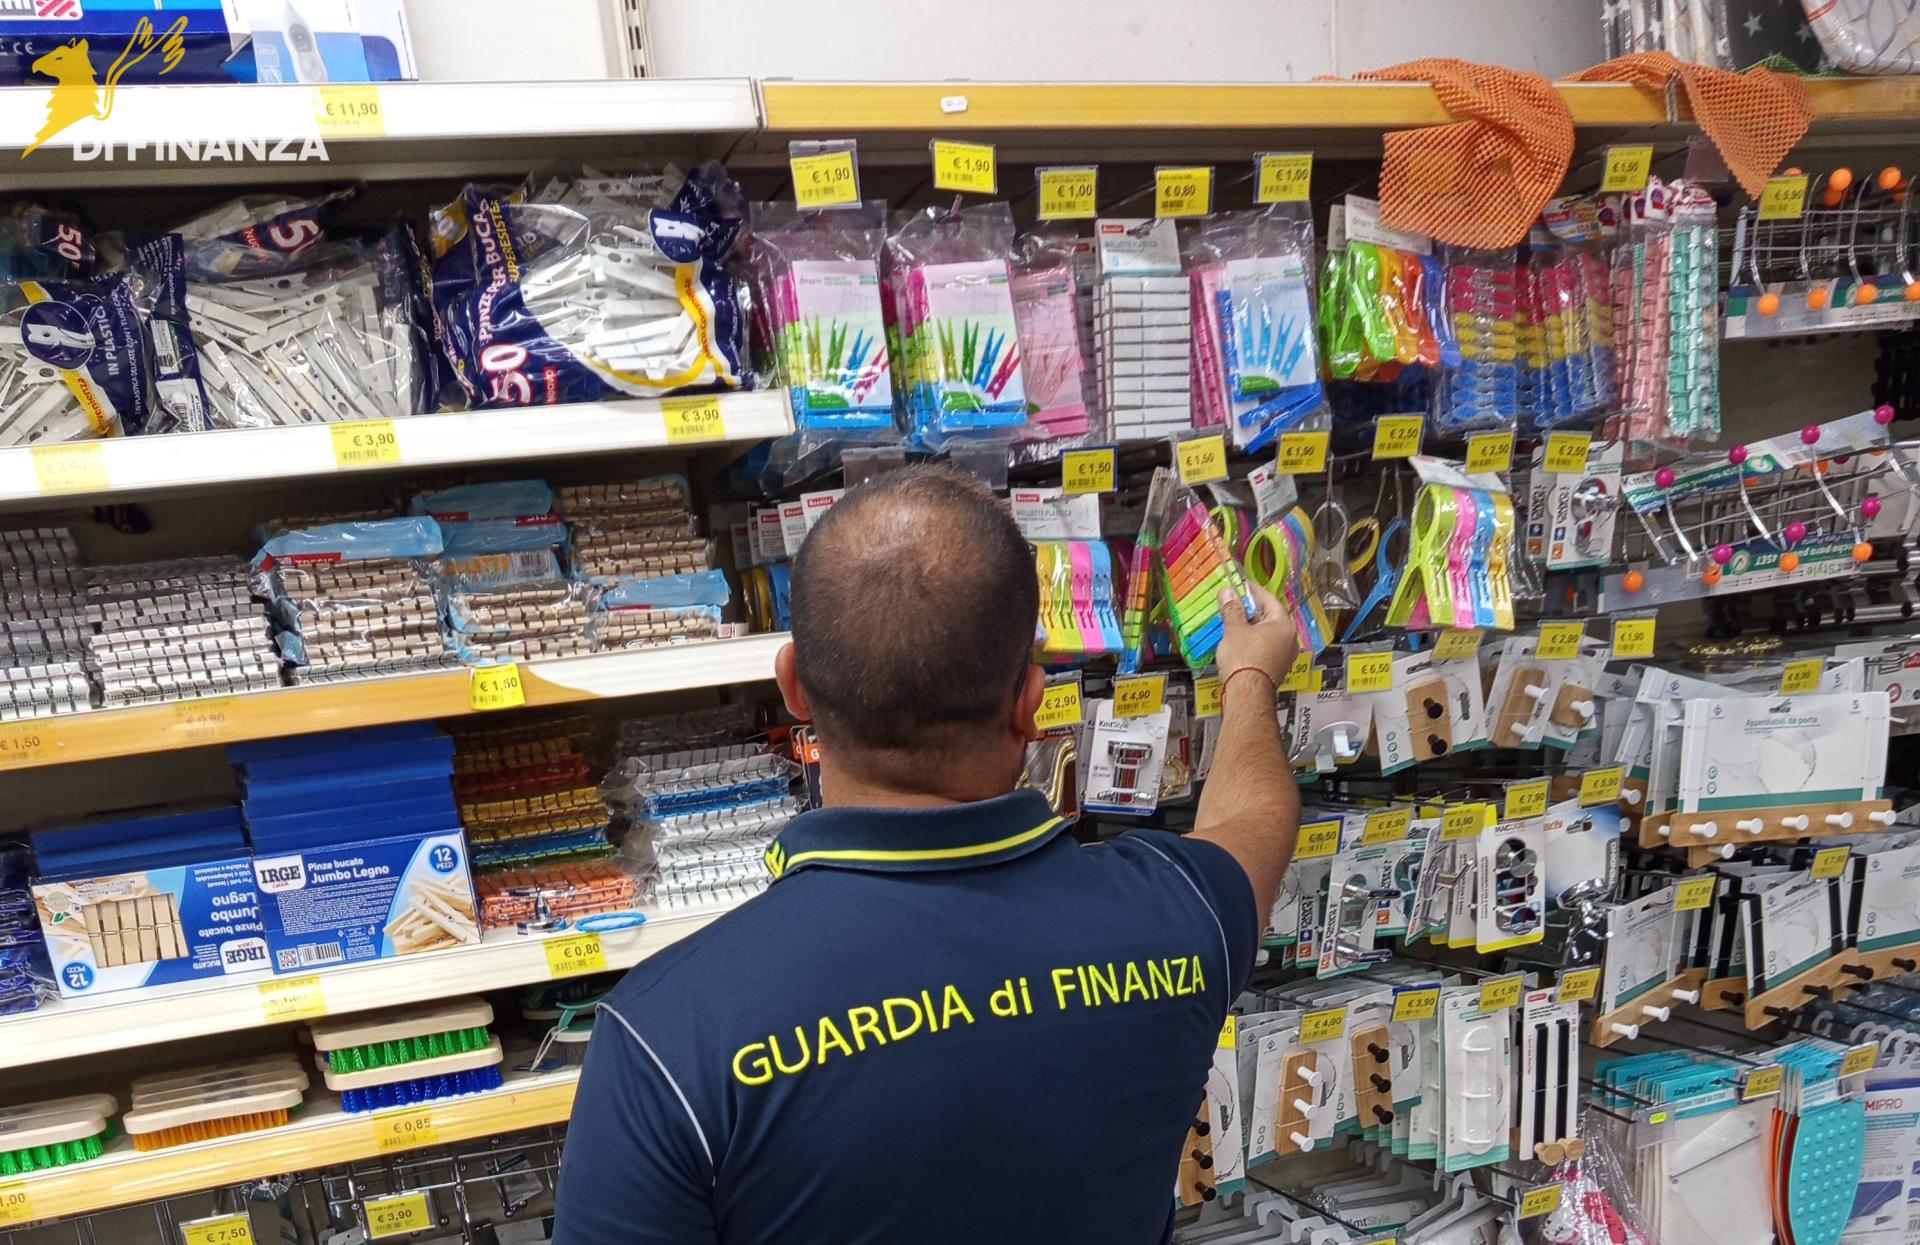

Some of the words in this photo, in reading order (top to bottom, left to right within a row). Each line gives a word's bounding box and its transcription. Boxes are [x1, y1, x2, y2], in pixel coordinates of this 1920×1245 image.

[325, 103, 334, 115] €
[338, 102, 378, 117] 11,90
[953, 158, 961, 169] €
[963, 159, 990, 172] 1,90
[1612, 163, 1620, 173] €
[812, 173, 819, 183] €
[825, 167, 850, 182] 1,90
[1057, 185, 1065, 196] €
[1068, 184, 1093, 198] 1,00
[56, 223, 82, 260] 50
[486, 266, 506, 296] PER
[477, 294, 499, 341] PINZE
[106, 359, 120, 376] IN
[127, 348, 139, 376] DELICATE
[481, 343, 533, 404] 50
[681, 410, 690, 422] €
[692, 408, 719, 423] 3,90
[353, 434, 363, 447] €
[365, 432, 395, 448] 3,90
[1389, 428, 1397, 439] €
[1397, 427, 1418, 440] 2,50
[1481, 445, 1488, 456] €
[1488, 443, 1510, 456] 2,50
[1559, 445, 1565, 456] €
[1186, 455, 1194, 466] €
[1195, 451, 1215, 465] 1,50
[1078, 464, 1086, 475] €
[1089, 461, 1111, 475] 1,50
[1551, 634, 1558, 644] €
[1360, 664, 1367, 674] €
[1369, 663, 1390, 675] 6,50
[480, 680, 489, 692] €
[493, 676, 518, 692] 1,50
[1045, 699, 1053, 710] €
[1054, 694, 1077, 709] 2,90
[0, 740, 9, 751] €
[13, 735, 41, 751] 1,50
[1519, 795, 1526, 804] €
[1526, 792, 1545, 803] 7,90
[1448, 819, 1455, 829] €
[434, 847, 453, 862] 12
[307, 860, 333, 872] Pinze
[333, 857, 364, 868] bucato
[435, 860, 455, 870] PEZZI
[259, 865, 302, 884] IRGE
[311, 869, 352, 884] Jumbo
[352, 865, 390, 879] Legno
[212, 891, 258, 907] Legno
[211, 906, 260, 923] Jumbo
[198, 924, 234, 938] bucato
[235, 921, 264, 933] Pinze
[224, 945, 266, 965] IRGE
[563, 947, 572, 958] €
[573, 942, 601, 958] 0,80
[193, 959, 222, 970] BUCATO
[68, 972, 89, 988] 12
[1492, 988, 1499, 998] €
[1499, 984, 1519, 996] 1,90
[1408, 999, 1415, 1009] €
[1415, 997, 1435, 1008] 3,90
[733, 984, 975, 1086] GUARDIA
[989, 977, 1034, 1017] di
[1052, 955, 1206, 1010] FINANZA
[393, 1122, 402, 1134] €
[403, 1117, 431, 1134] 0,85
[377, 1213, 386, 1223] €
[387, 1209, 412, 1222] 3,90
[206, 1232, 216, 1243] €
[218, 1226, 247, 1241] 7,50
